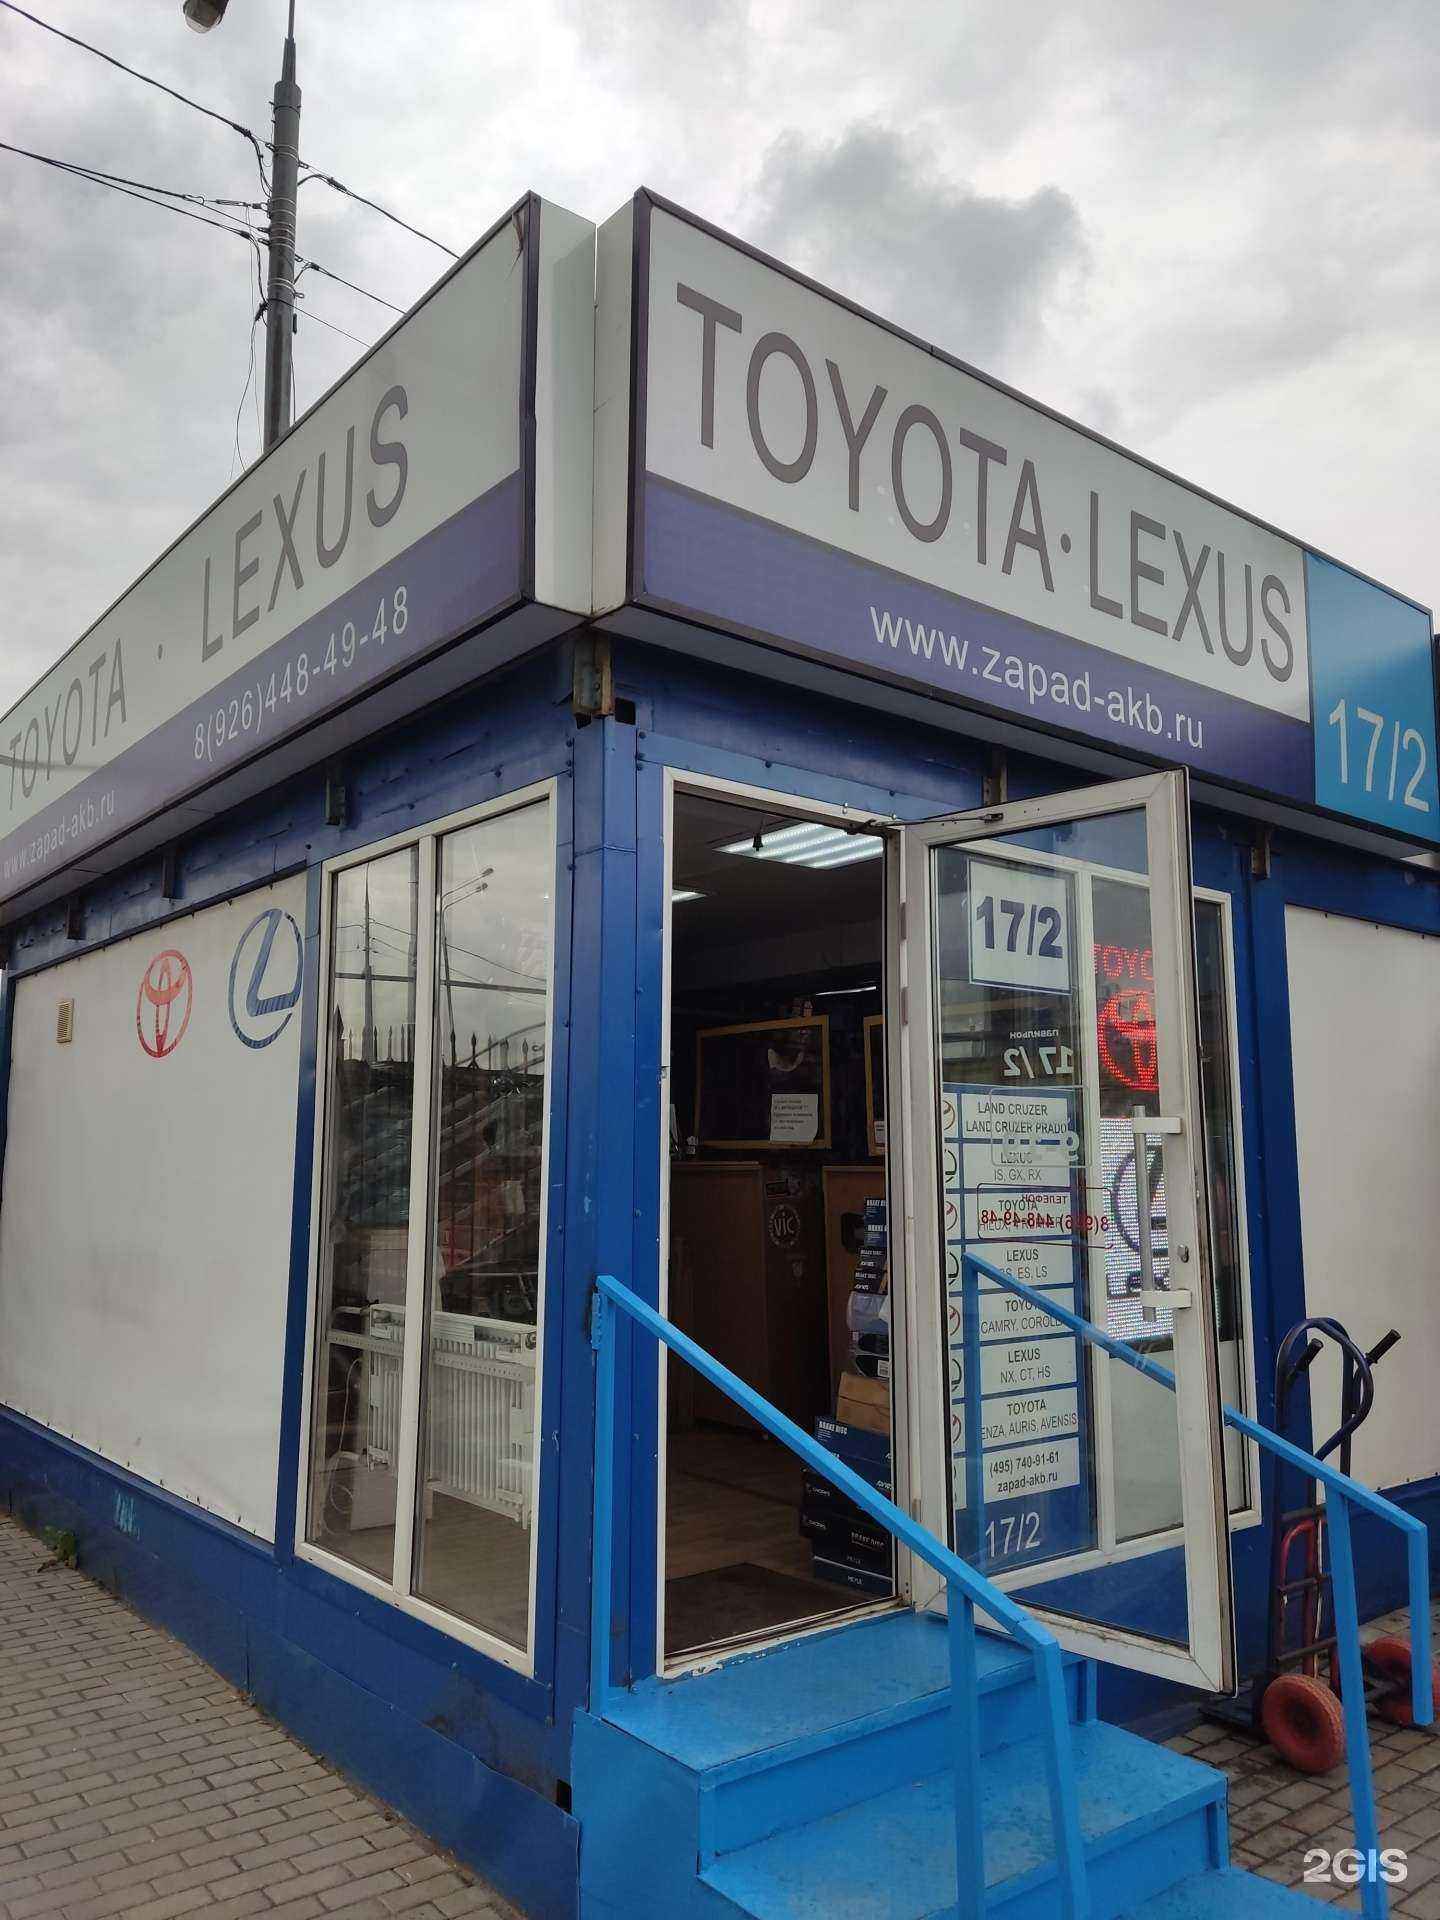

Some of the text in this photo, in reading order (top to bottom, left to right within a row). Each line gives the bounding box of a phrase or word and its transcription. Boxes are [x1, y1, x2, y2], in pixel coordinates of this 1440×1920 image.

[676, 282, 1294, 683] TOYOTA LEXUS
[9, 384, 408, 811] TOYOTA LEXUS
[193, 585, 408, 762] 8(926)448-49-48
[870, 606, 1205, 749] www.zapad-akb.ru
[1328, 698, 1430, 813] 17/2
[3, 789, 115, 879] www.zapad-akb.ru
[976, 896, 1064, 959] 17/2
[978, 1102, 1048, 1116] LAND CRUZER
[966, 1120, 992, 1132] LAND
[995, 1121, 1033, 1134] CRUZER
[1028, 1168, 1042, 1180] RX
[1006, 1249, 1039, 1262] LEXUS
[1035, 1265, 1048, 1278] LS
[1005, 1299, 1038, 1312] TOYO
[1021, 1315, 1063, 1330] COROLL
[1008, 1348, 1040, 1363] LEXUS
[1037, 1365, 1051, 1378] HS
[1007, 1399, 1047, 1416] TOYOTA
[981, 1425, 1006, 1440] ENZA,
[1041, 1412, 1078, 1429] AVENSIS
[998, 1471, 1058, 1493] zapad-akb.ru
[985, 1511, 1041, 1557] 17/2
